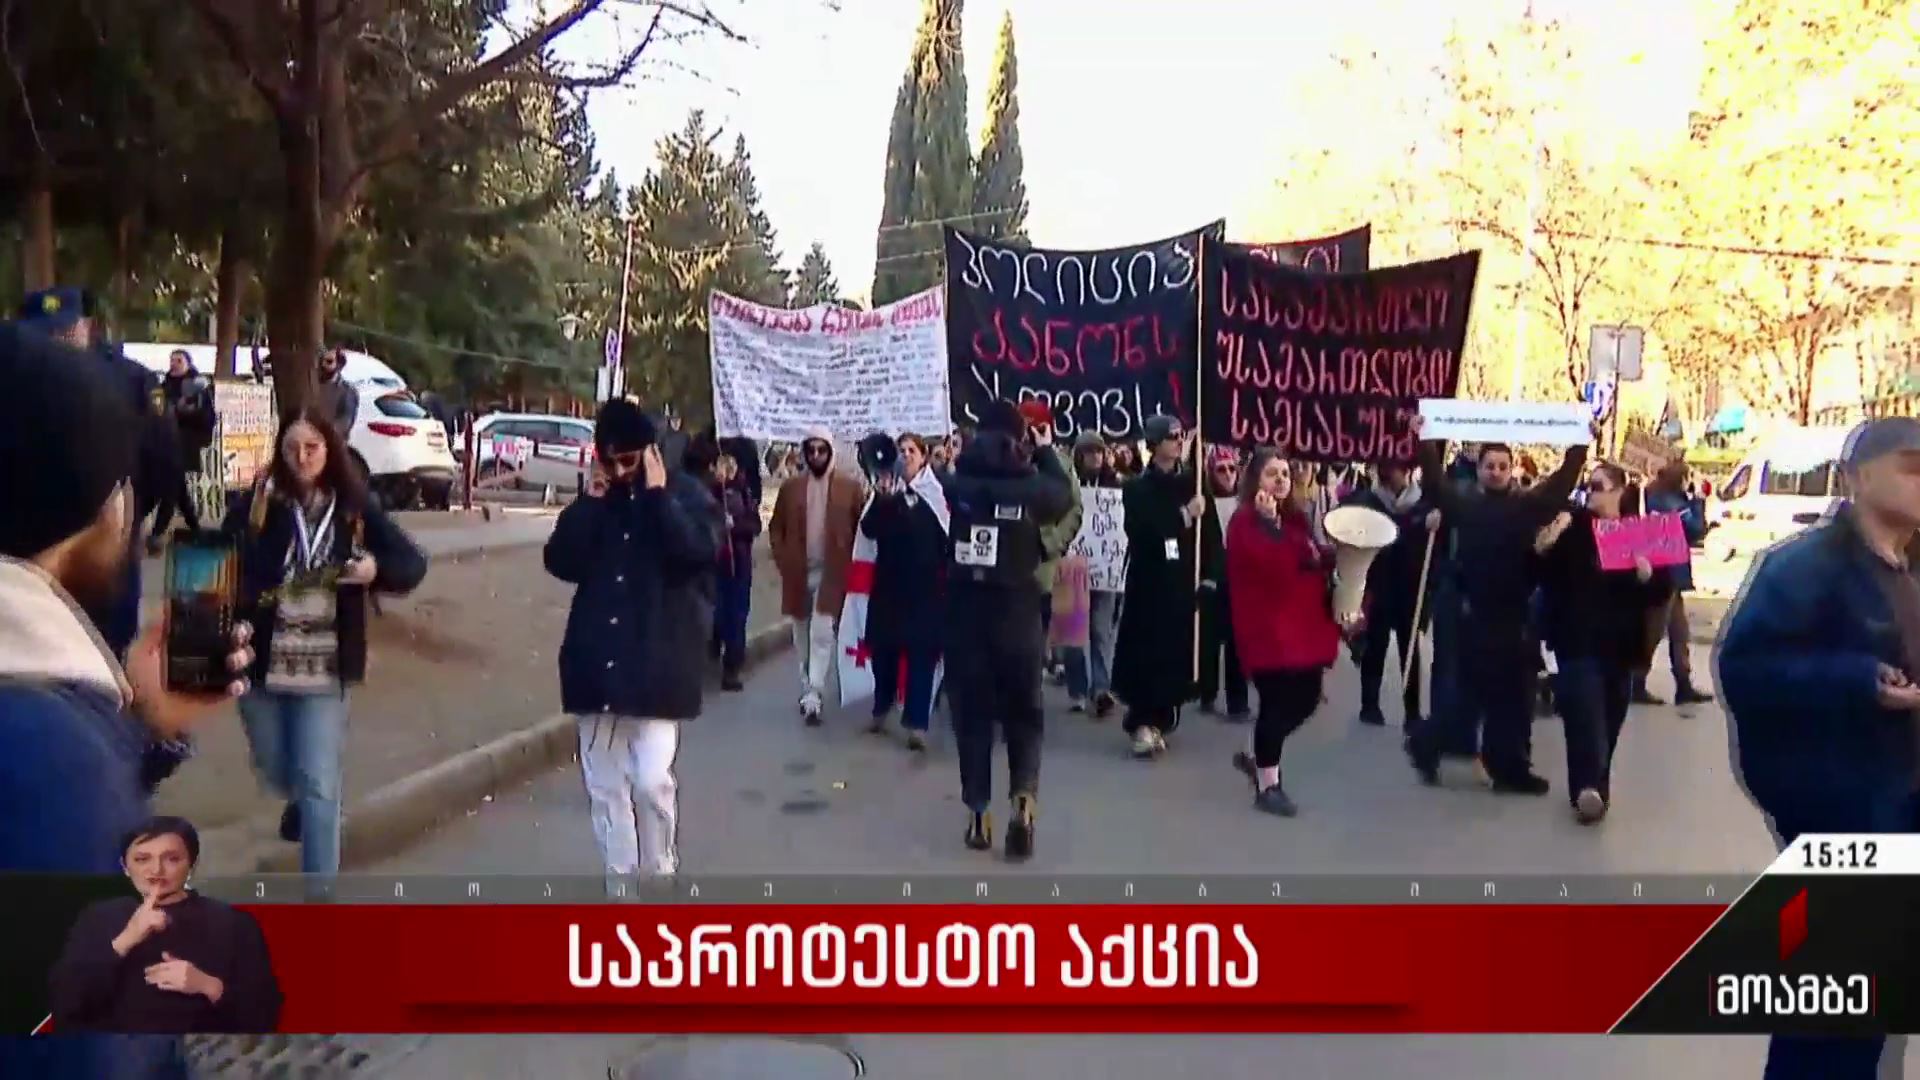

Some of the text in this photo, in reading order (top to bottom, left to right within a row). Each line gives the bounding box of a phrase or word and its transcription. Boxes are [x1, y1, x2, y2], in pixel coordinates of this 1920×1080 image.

[954, 230, 1196, 304] პოლიცია
[1221, 265, 1449, 335] სასამართლო
[972, 307, 1181, 376] კანონს
